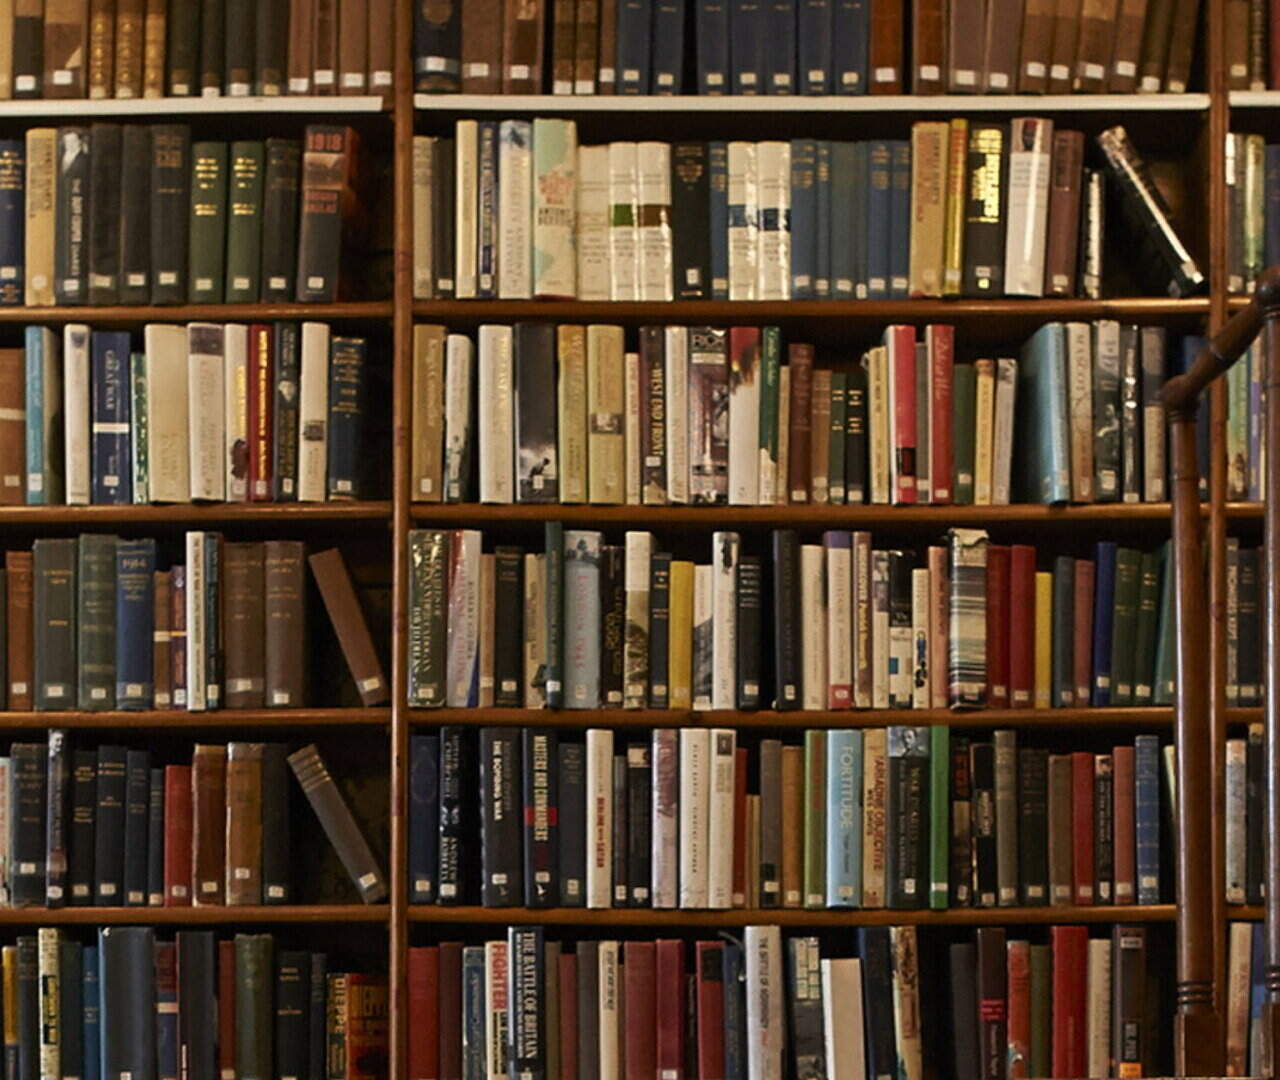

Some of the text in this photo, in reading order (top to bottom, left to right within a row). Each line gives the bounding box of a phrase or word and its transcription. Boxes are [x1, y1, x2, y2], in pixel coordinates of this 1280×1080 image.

[307, 133, 342, 151] 1918
[651, 369, 664, 456] WEST END FRONT
[493, 741, 503, 821] THE BOMBING WAR
[534, 772, 548, 787] AND
[839, 746, 854, 829] FORTITUDE
[335, 977, 347, 1033] DIEPPE
[492, 944, 508, 1010] FIGHTER
[523, 932, 538, 1059] THE BATTLE OF BRITAIN
